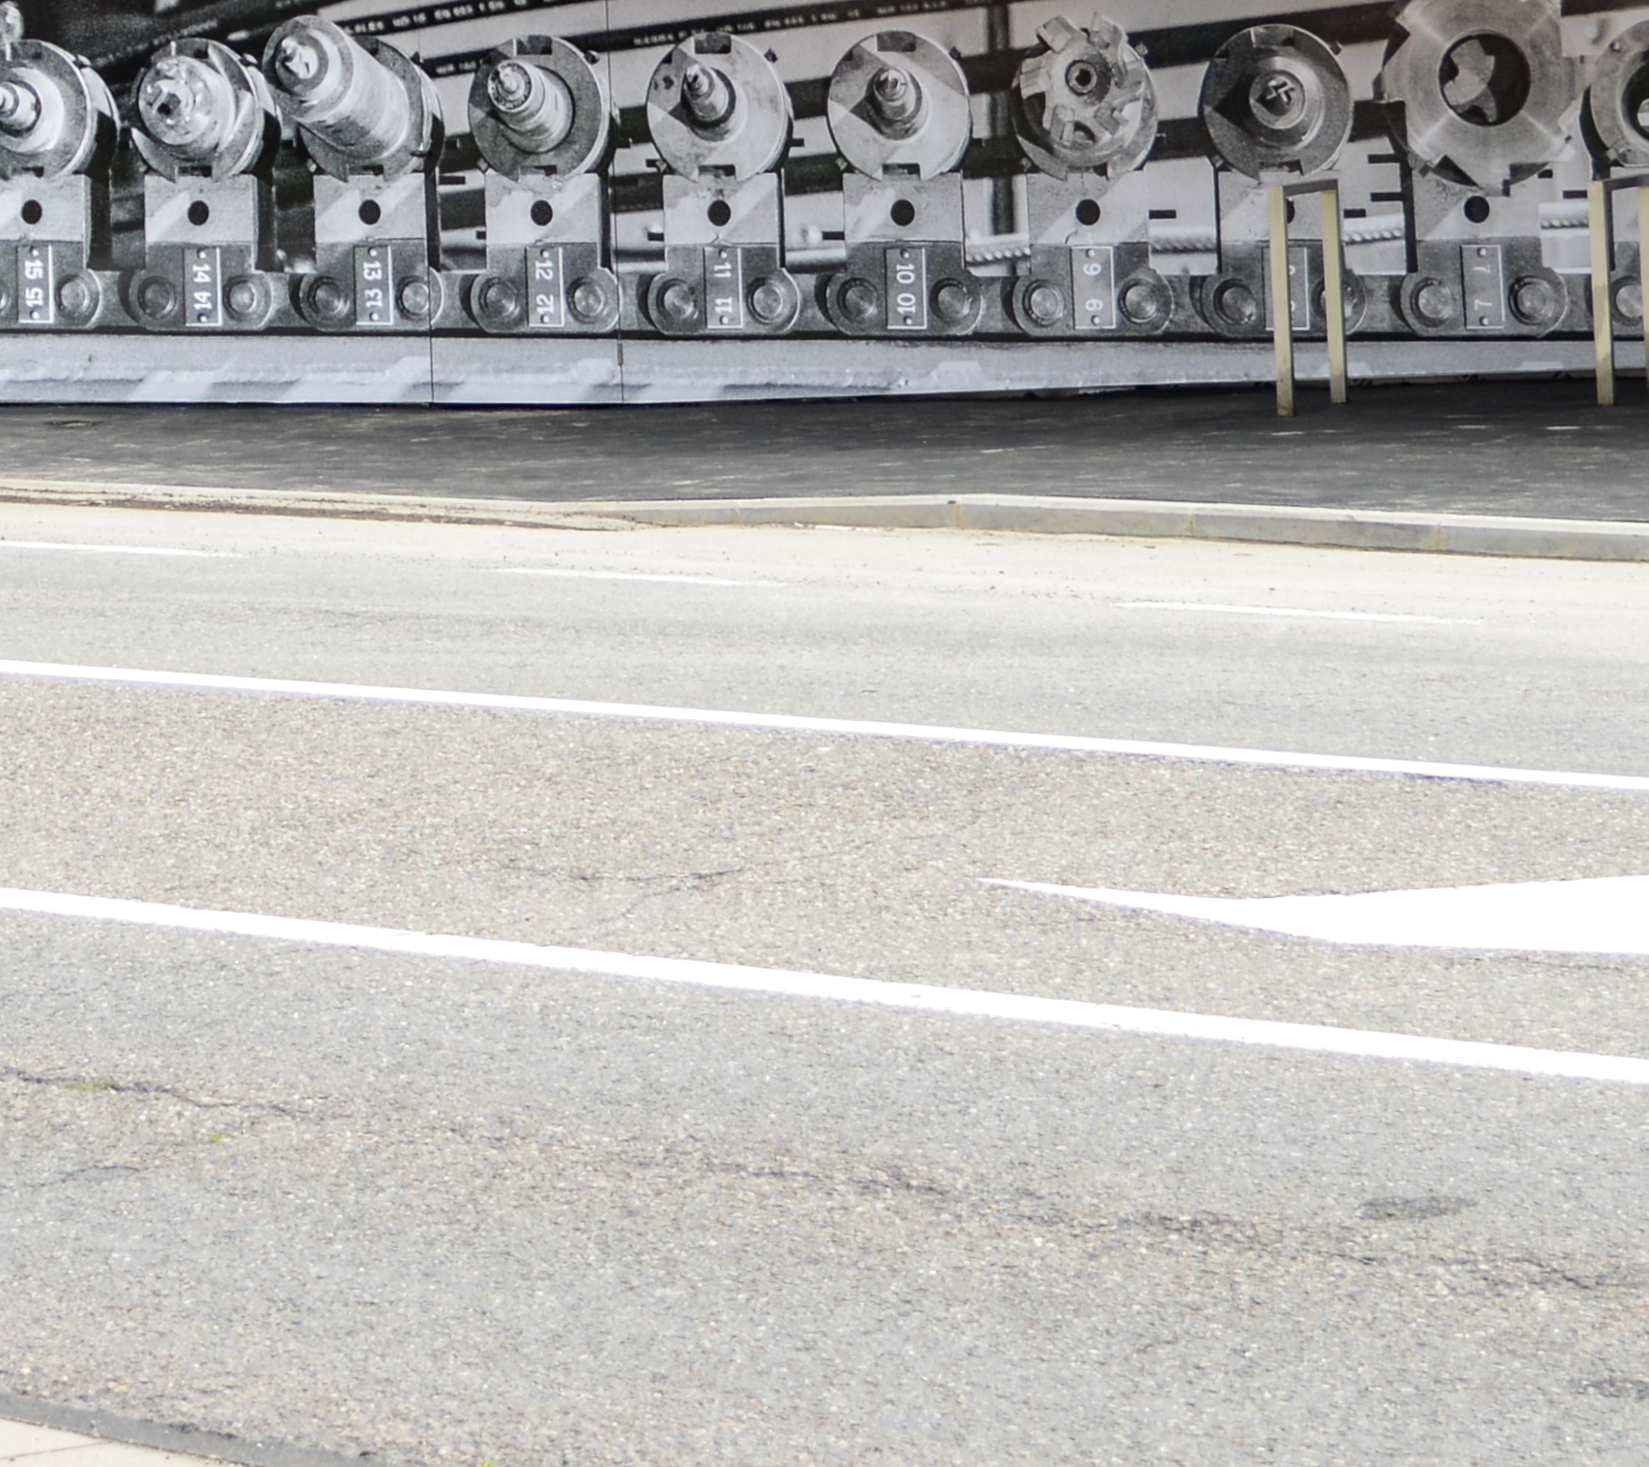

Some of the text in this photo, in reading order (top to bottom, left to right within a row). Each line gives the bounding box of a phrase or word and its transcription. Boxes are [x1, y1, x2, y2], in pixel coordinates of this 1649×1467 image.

[24, 259, 43, 280] 15
[192, 263, 211, 283] 14
[363, 261, 382, 281] 13
[535, 260, 554, 280] 12
[713, 262, 732, 278] 11
[896, 263, 915, 284] 10
[1472, 264, 1491, 274] 7
[25, 287, 44, 307] 15
[193, 290, 212, 310] 14
[364, 288, 384, 308] 13
[536, 293, 554, 312] 12
[714, 292, 733, 310] 11
[896, 293, 916, 314] 10
[1474, 298, 1493, 311] 7
